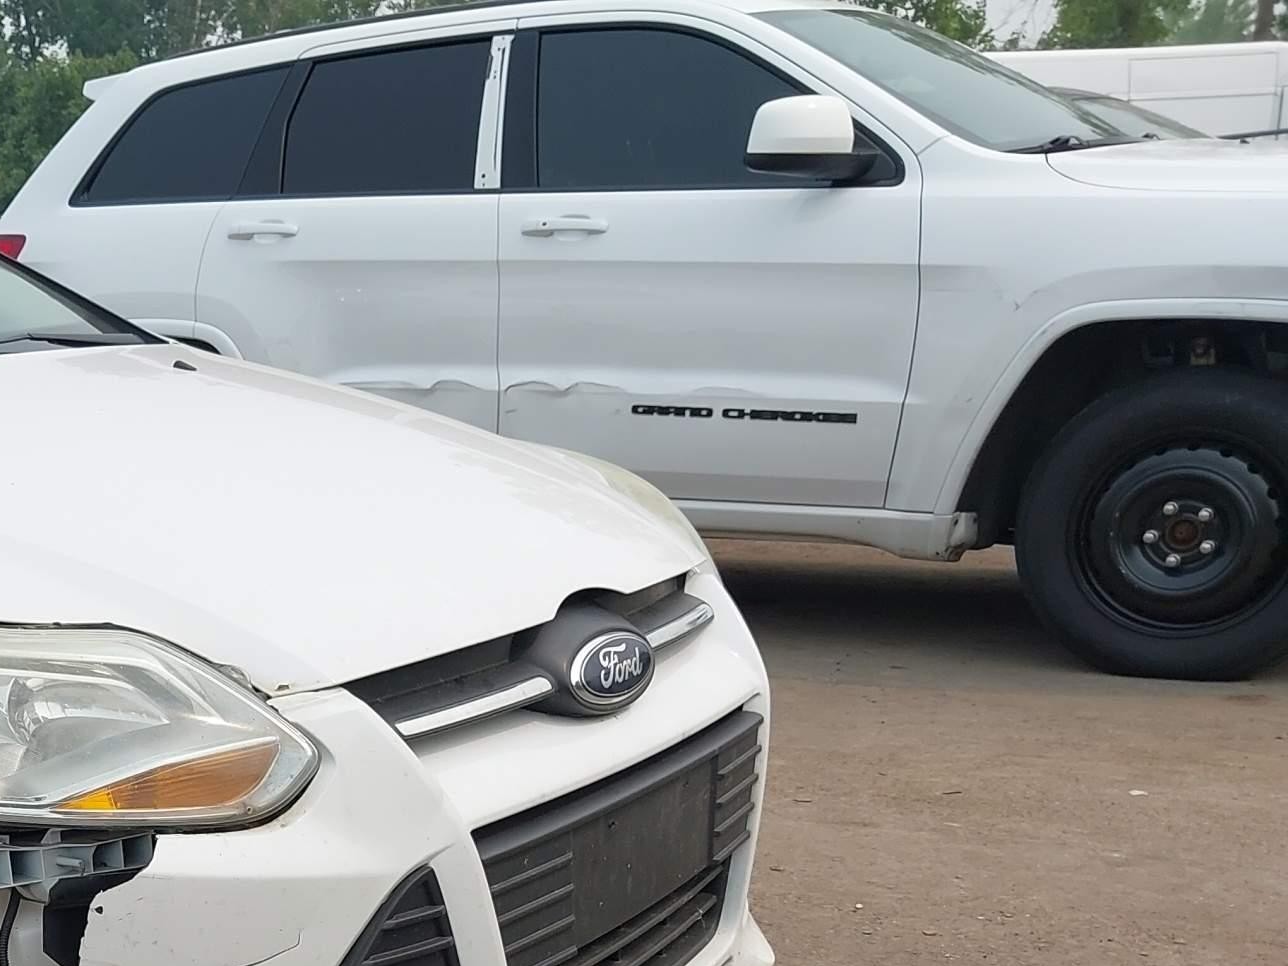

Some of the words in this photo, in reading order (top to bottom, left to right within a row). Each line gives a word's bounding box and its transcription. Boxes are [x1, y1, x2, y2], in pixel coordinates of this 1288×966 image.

[631, 405, 713, 418] GRAND
[722, 408, 858, 424] CHEROKEE
[599, 642, 643, 689] Ford
